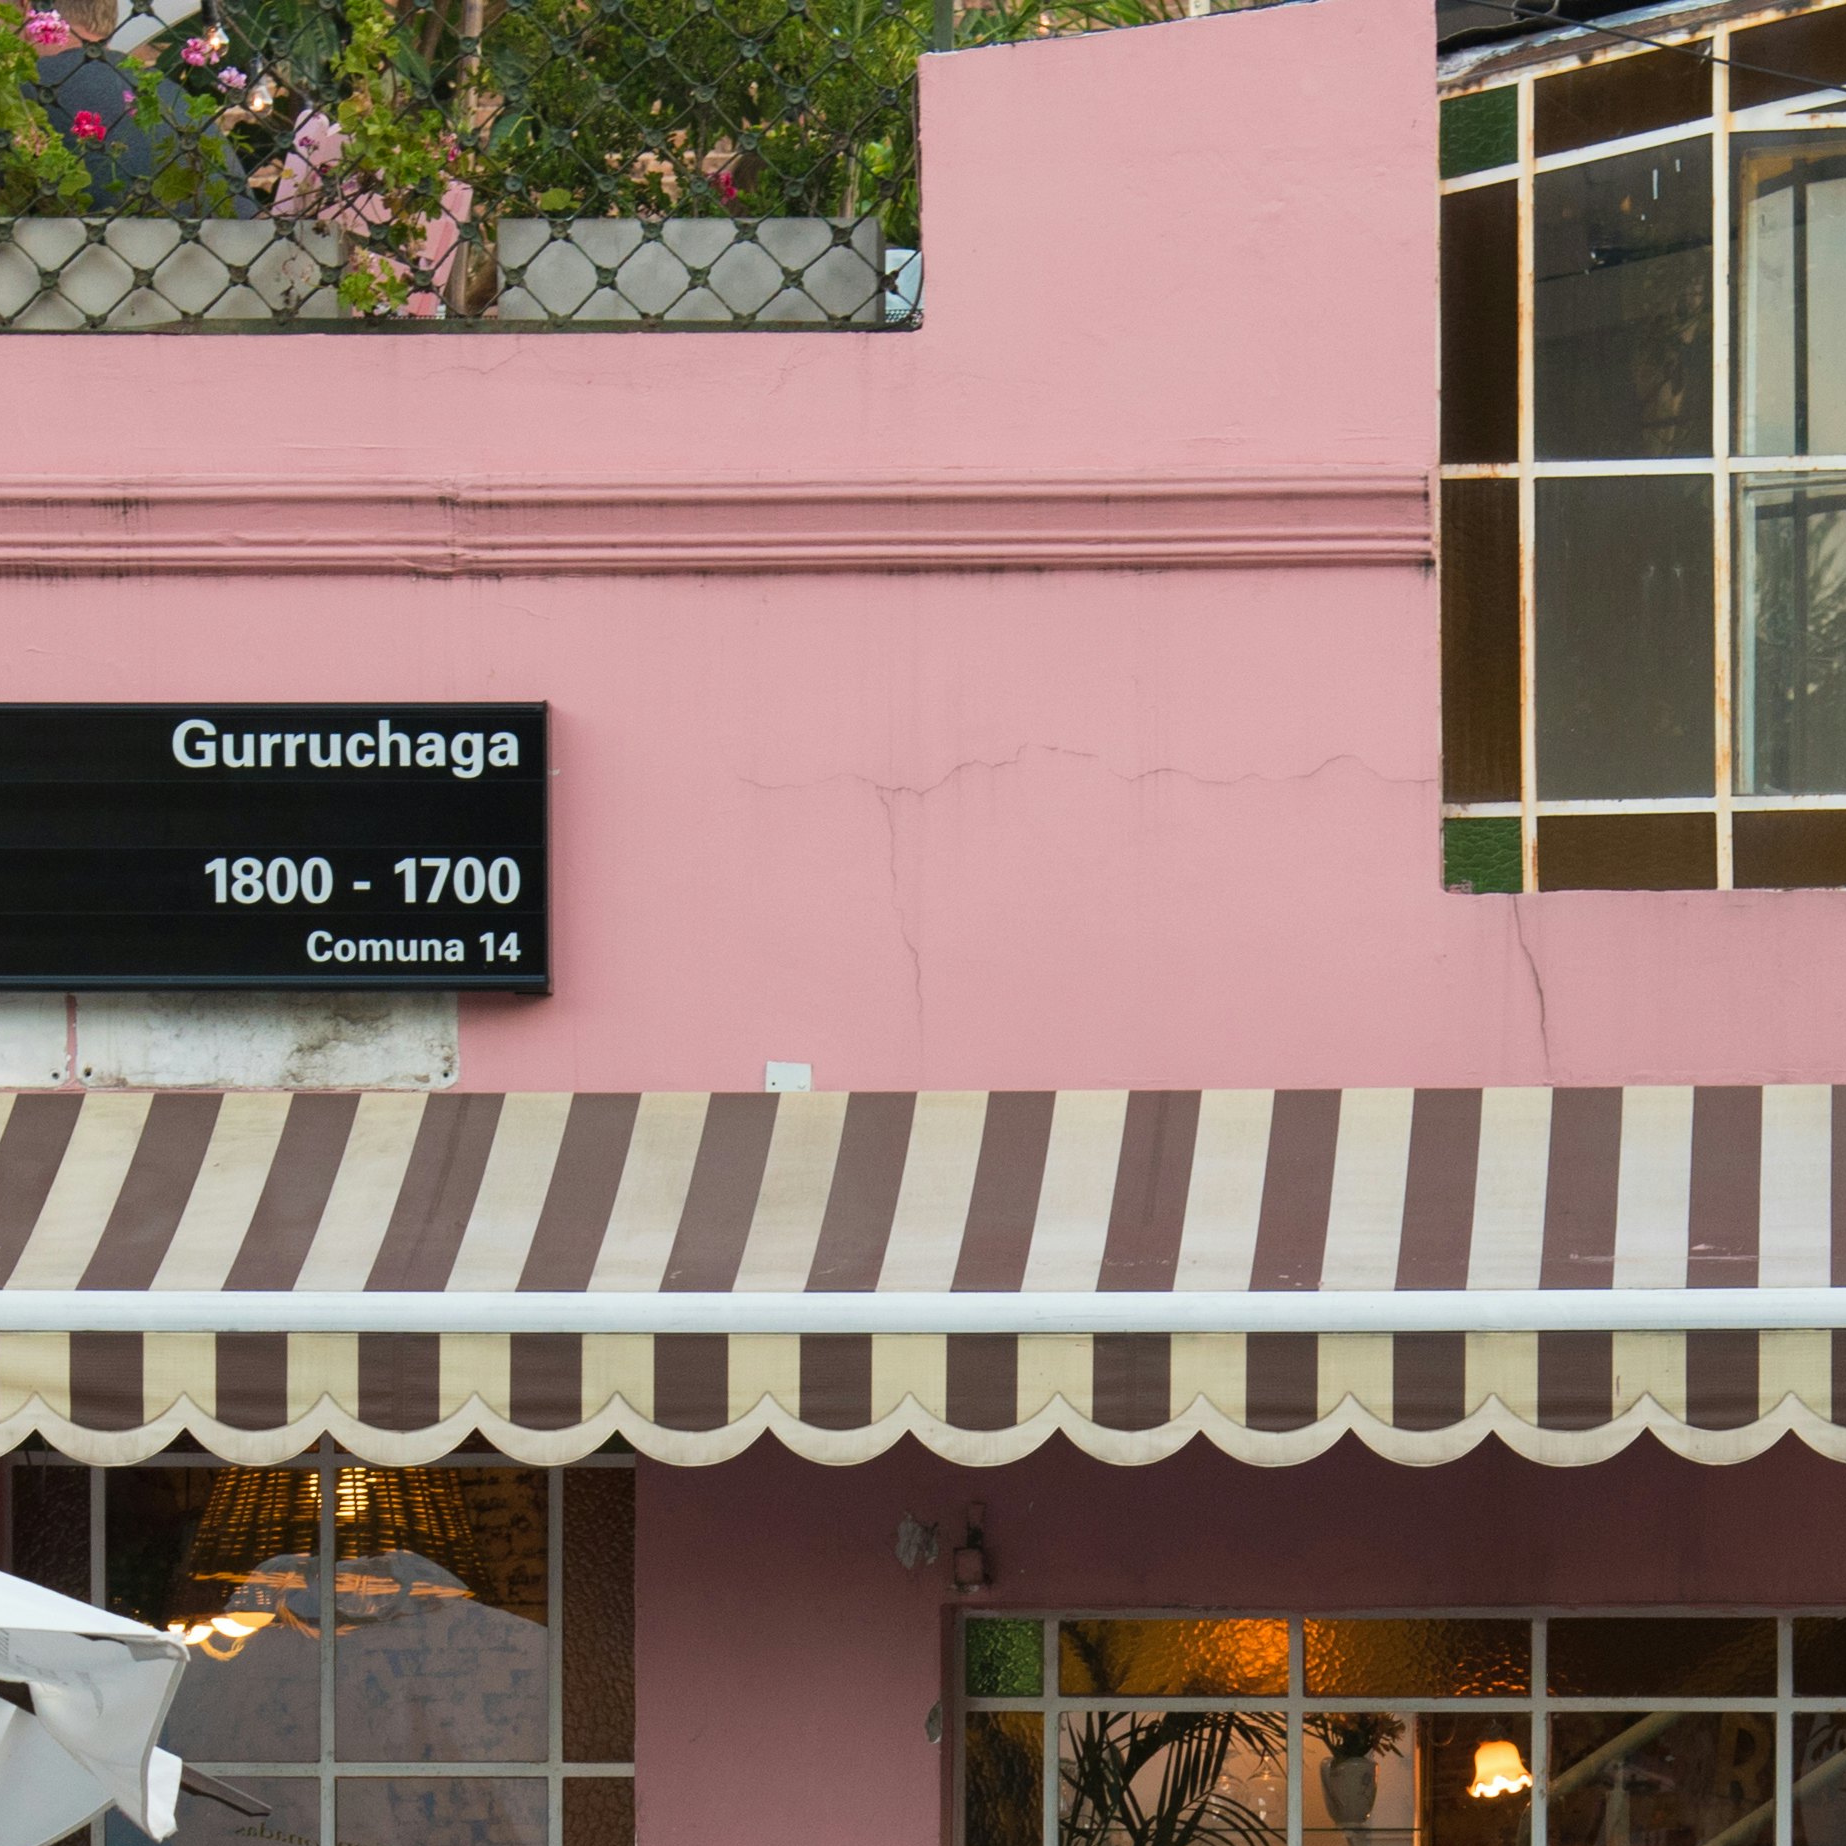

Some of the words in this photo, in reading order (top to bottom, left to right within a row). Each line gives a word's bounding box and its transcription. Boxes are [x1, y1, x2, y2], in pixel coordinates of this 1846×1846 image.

[172, 719, 520, 779] Gurruchaga
[204, 857, 334, 904] 1800
[353, 880, 371, 890] -
[394, 857, 521, 904] 1700
[306, 930, 466, 962] Comuna
[479, 932, 522, 962] 14
